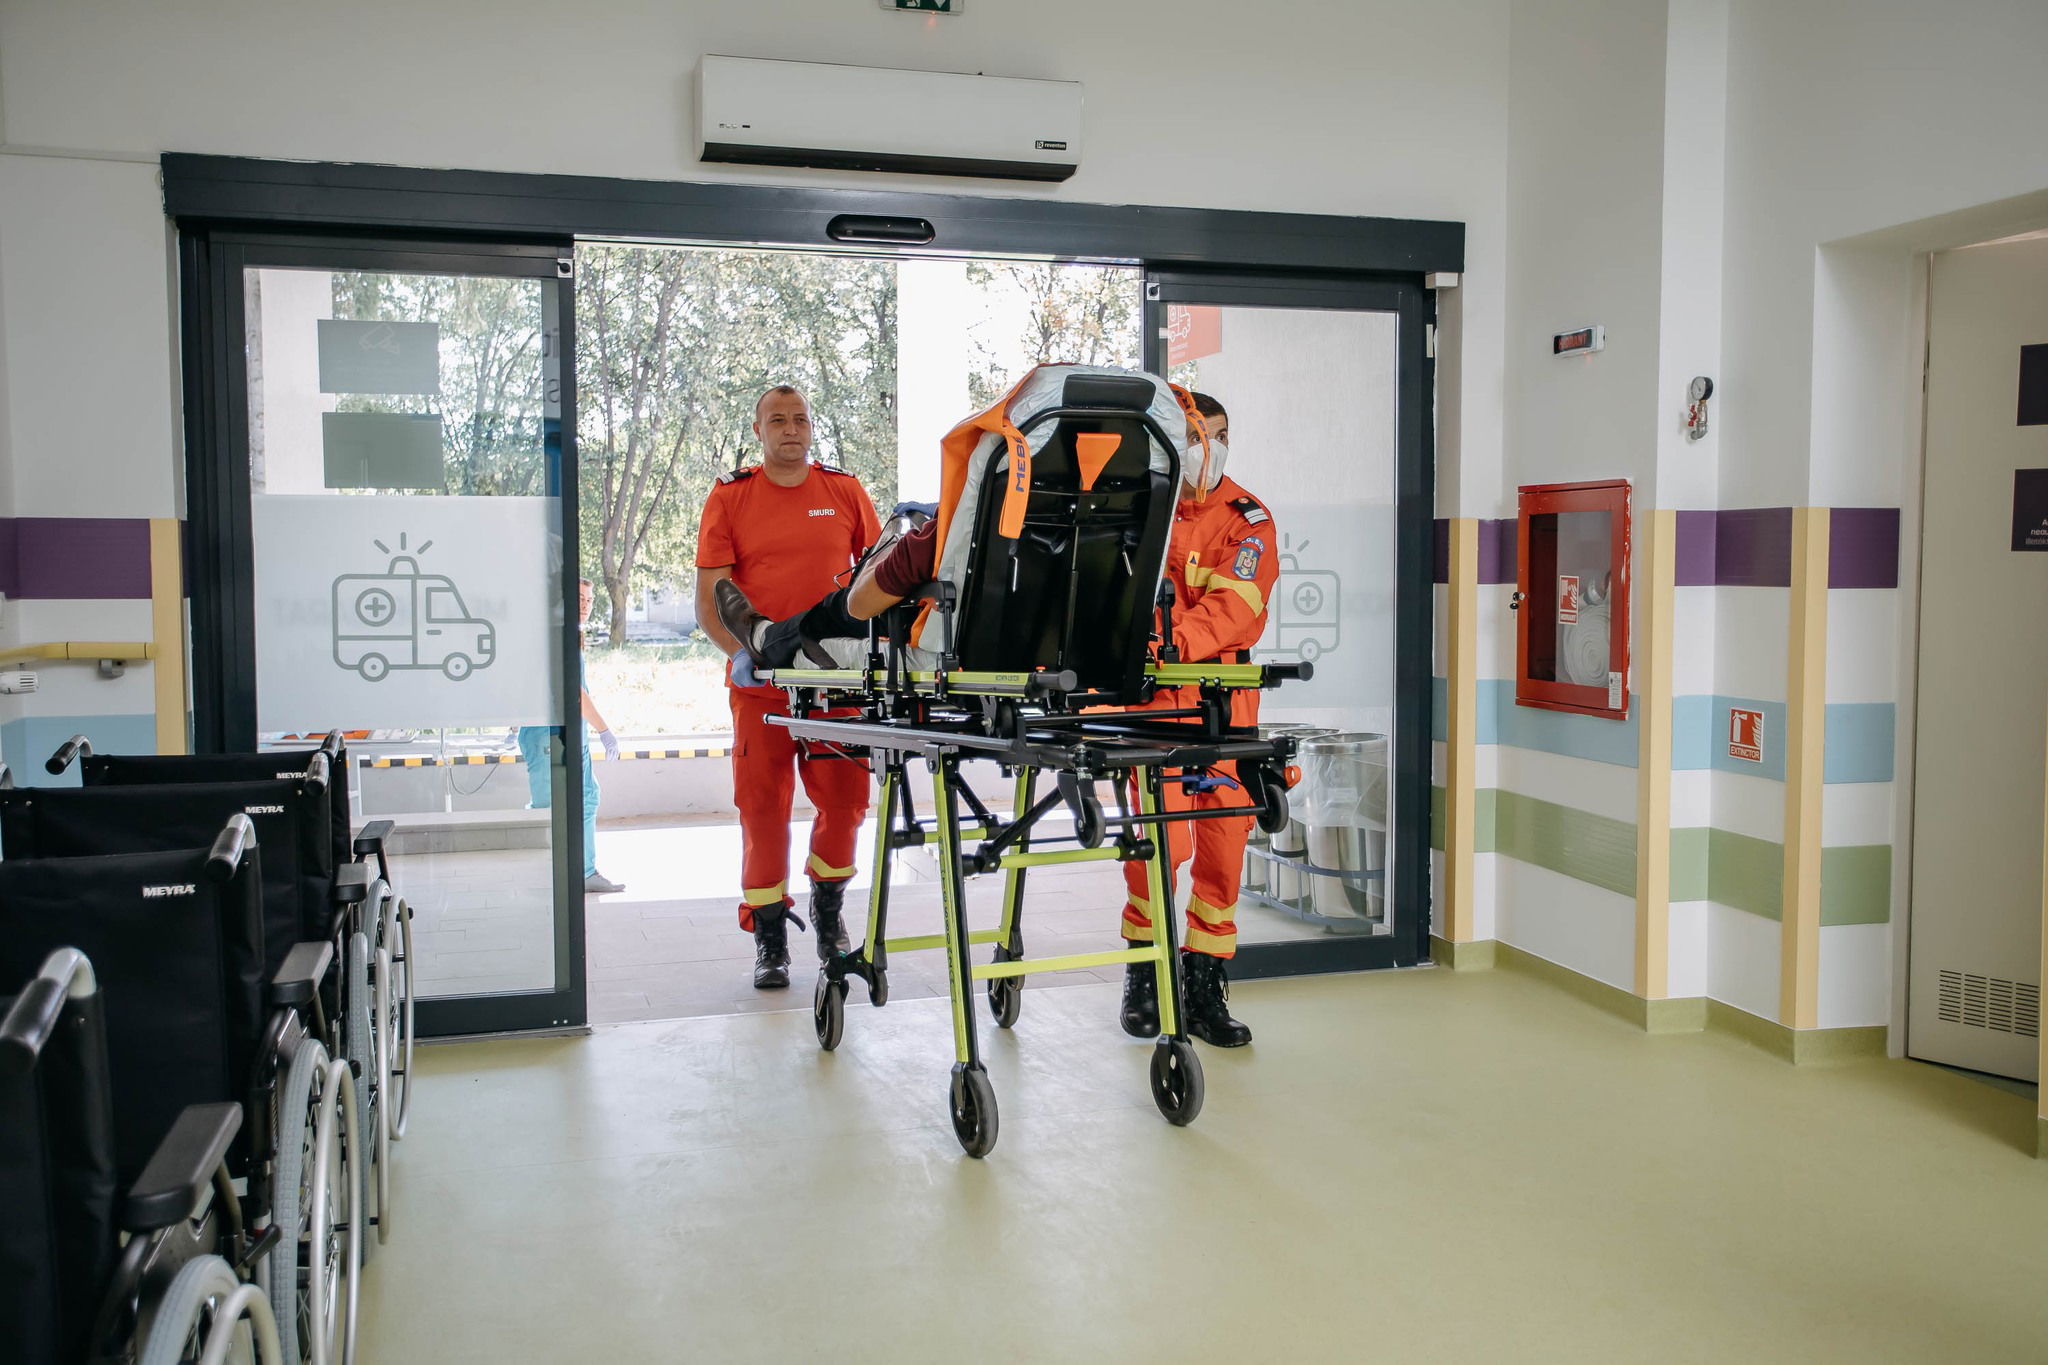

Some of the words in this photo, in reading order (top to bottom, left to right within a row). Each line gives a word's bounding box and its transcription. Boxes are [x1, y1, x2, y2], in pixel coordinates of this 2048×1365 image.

[808, 508, 836, 517] SMURD
[1730, 745, 1760, 760] EXTINCTOR
[245, 805, 284, 814] MEYRA
[142, 884, 196, 898] MEYRA
